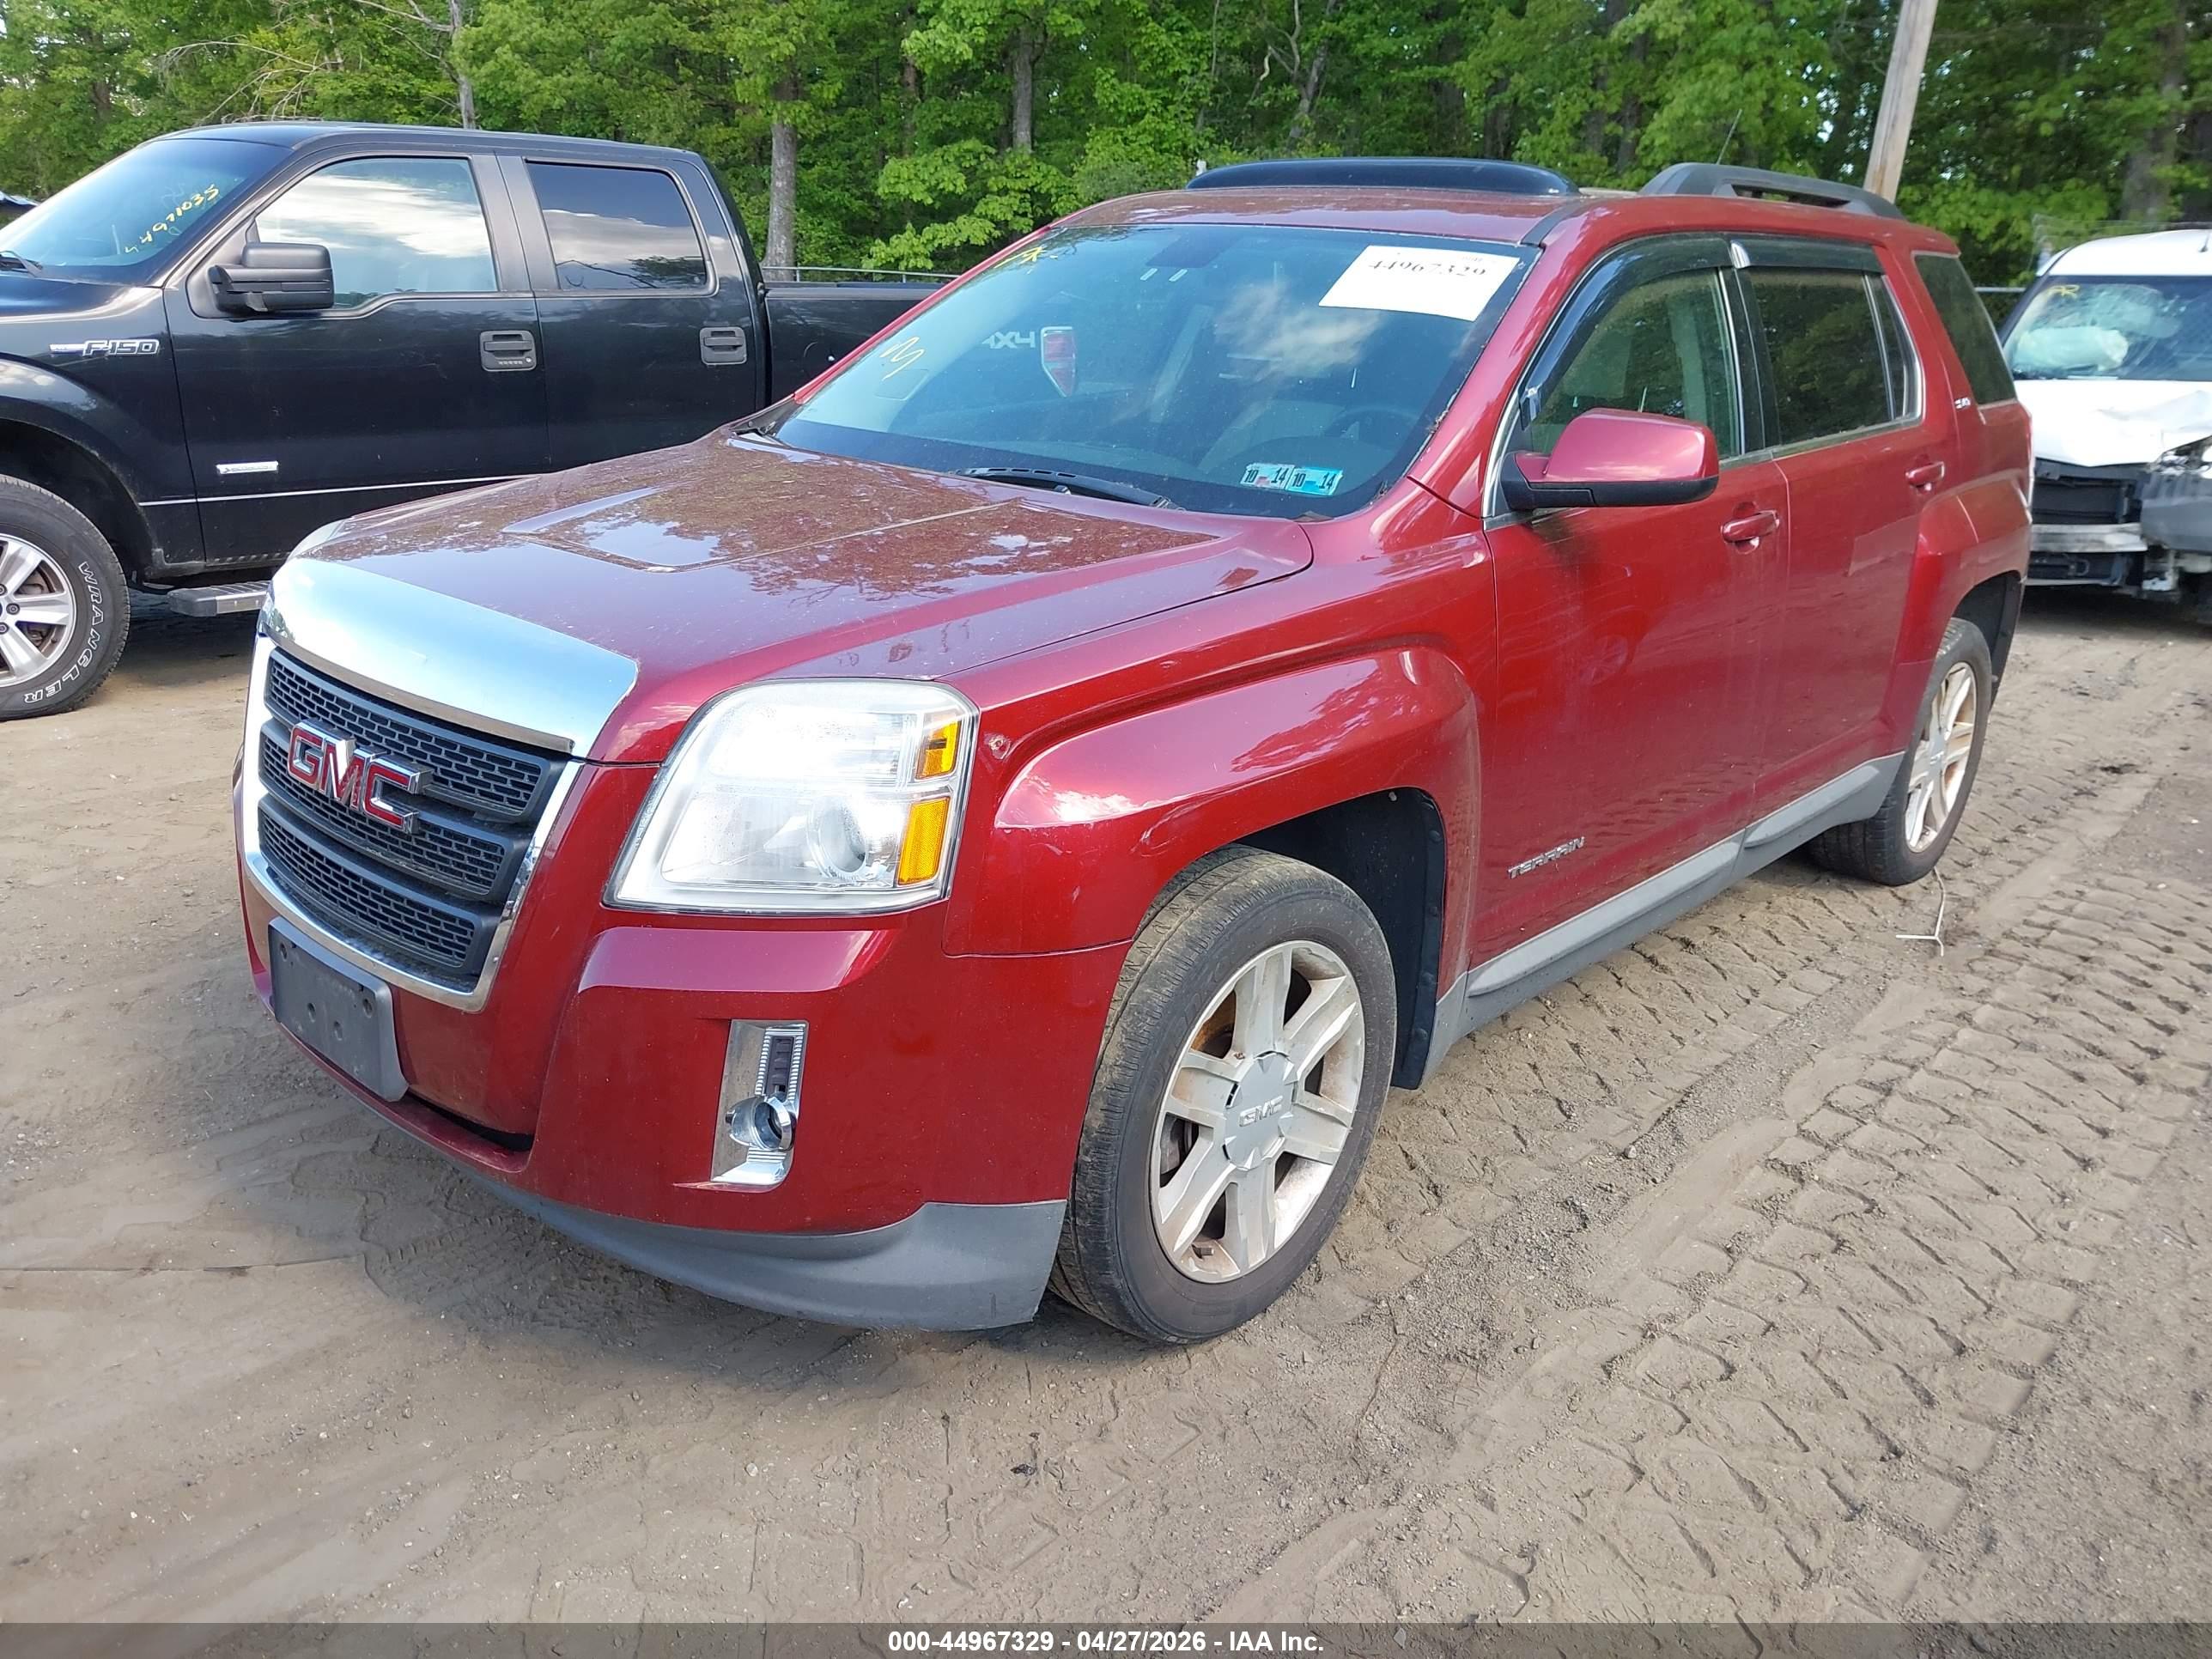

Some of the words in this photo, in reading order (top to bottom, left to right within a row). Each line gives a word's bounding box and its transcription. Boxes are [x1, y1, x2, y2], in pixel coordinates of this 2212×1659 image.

[1244, 469, 1259, 483] 10
[1271, 467, 1289, 484] 14
[1291, 472, 1307, 488] 10
[1319, 472, 1336, 490] 14
[24, 562, 104, 703] WRANGLER
[288, 719, 422, 834] GMC
[1507, 836, 1585, 879] TERRAIN
[1239, 1095, 1284, 1127] GMC
